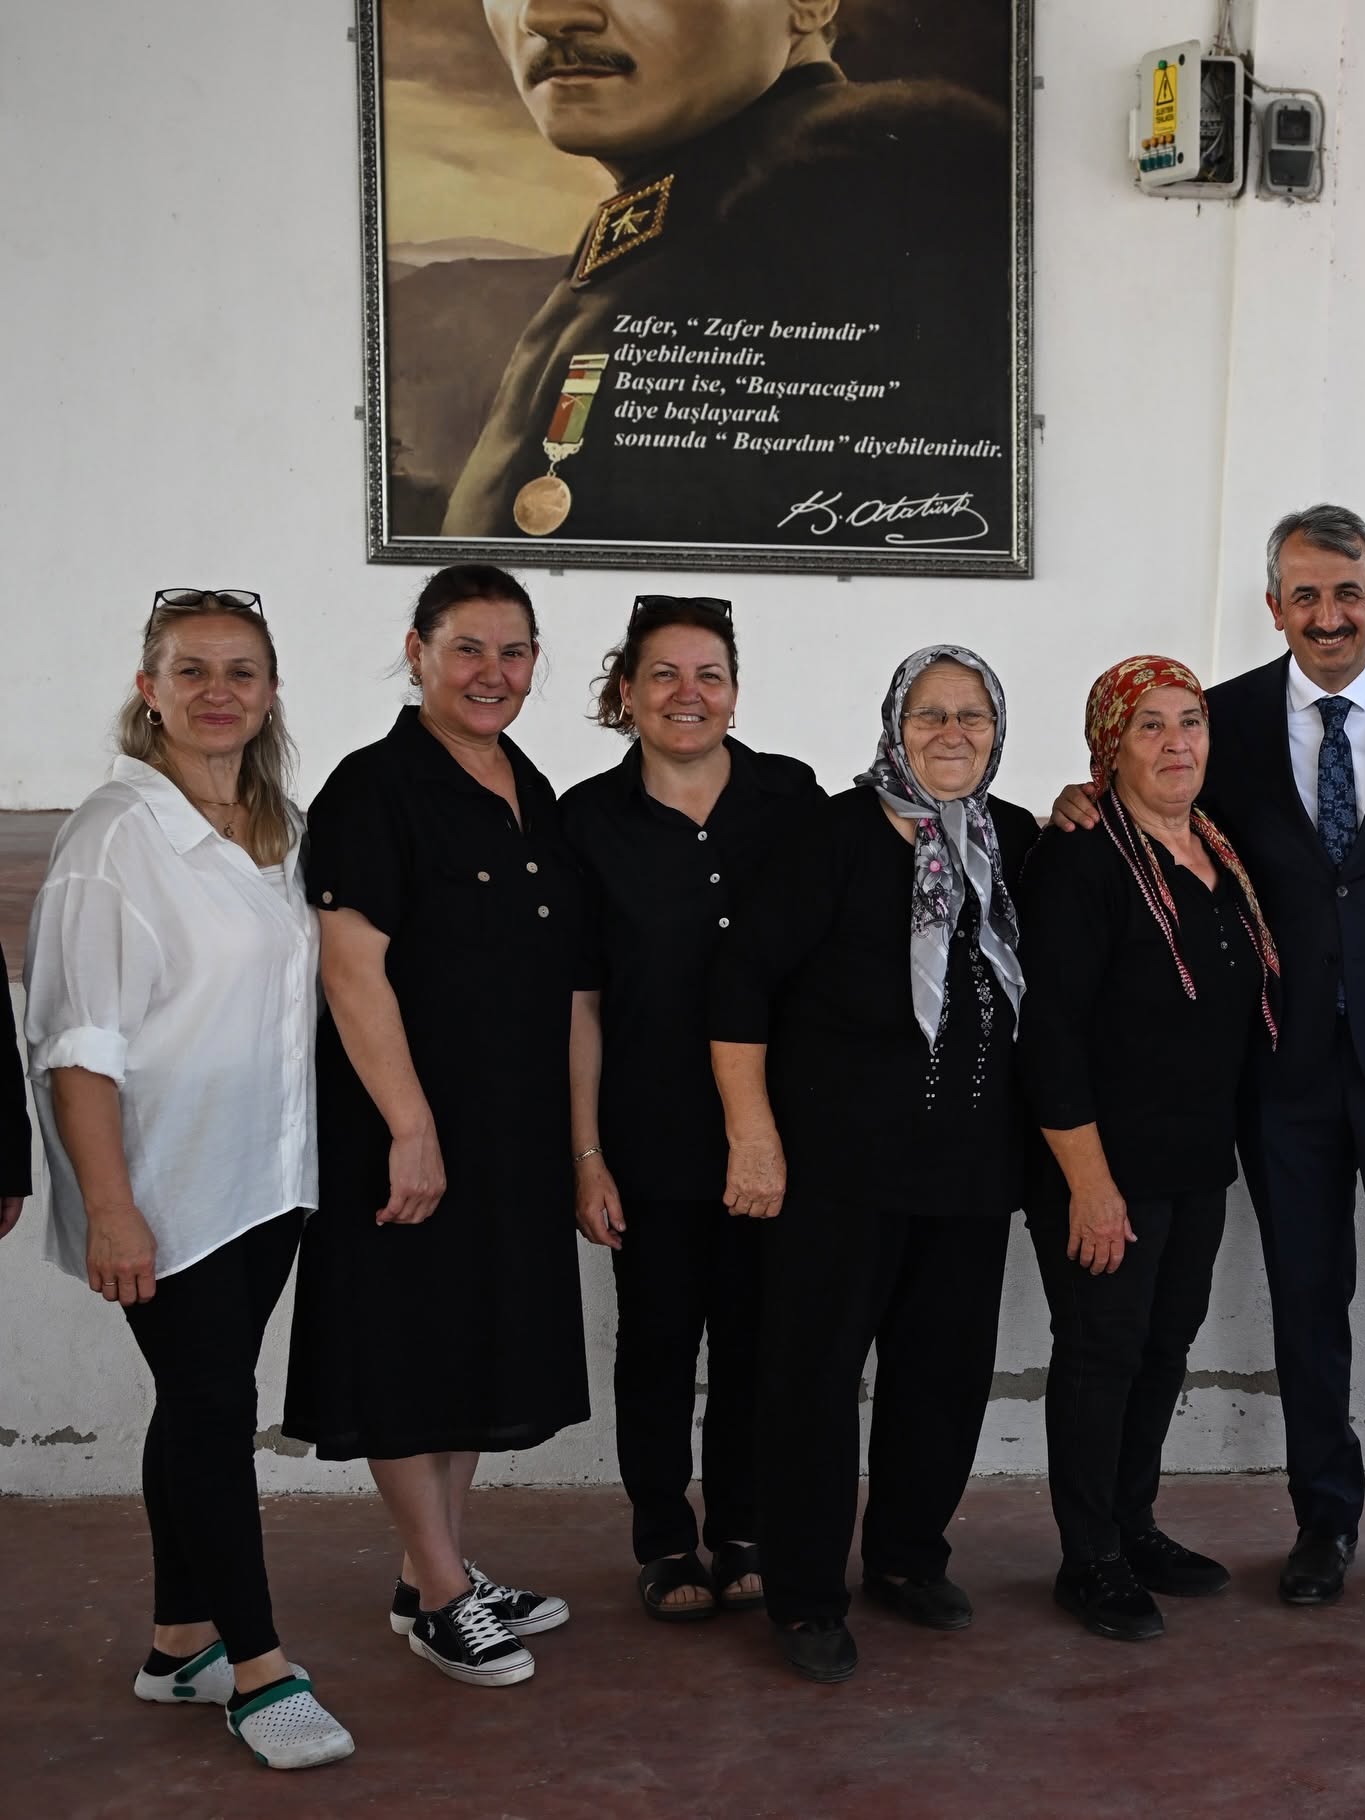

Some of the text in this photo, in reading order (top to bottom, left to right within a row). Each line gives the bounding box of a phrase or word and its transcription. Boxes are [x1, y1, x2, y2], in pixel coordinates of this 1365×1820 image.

[613, 315, 677, 337] Zafer,
[614, 344, 765, 366] diyebilenindir.
[615, 372, 685, 394] Başarı
[692, 375, 725, 394] ise,
[615, 400, 779, 425] diye başlayarak
[615, 431, 706, 448] sonunda
[855, 436, 1002, 458] diyebilenindir.
